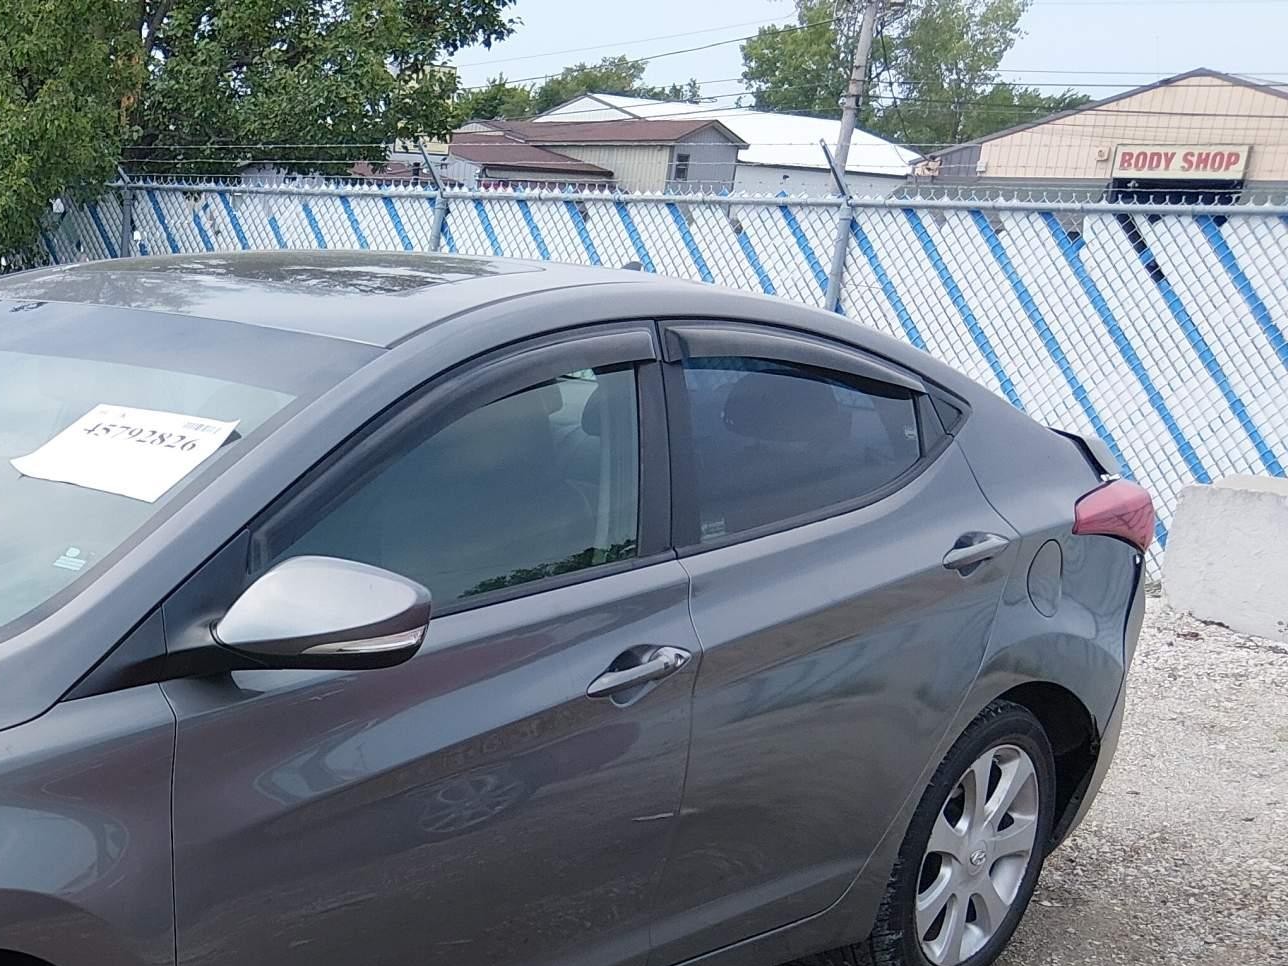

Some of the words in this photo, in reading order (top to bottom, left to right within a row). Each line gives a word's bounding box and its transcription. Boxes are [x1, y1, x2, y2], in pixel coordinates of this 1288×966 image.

[1119, 151, 1177, 171] BODY
[1181, 151, 1240, 172] SHOP
[84, 422, 198, 452] 45792826
